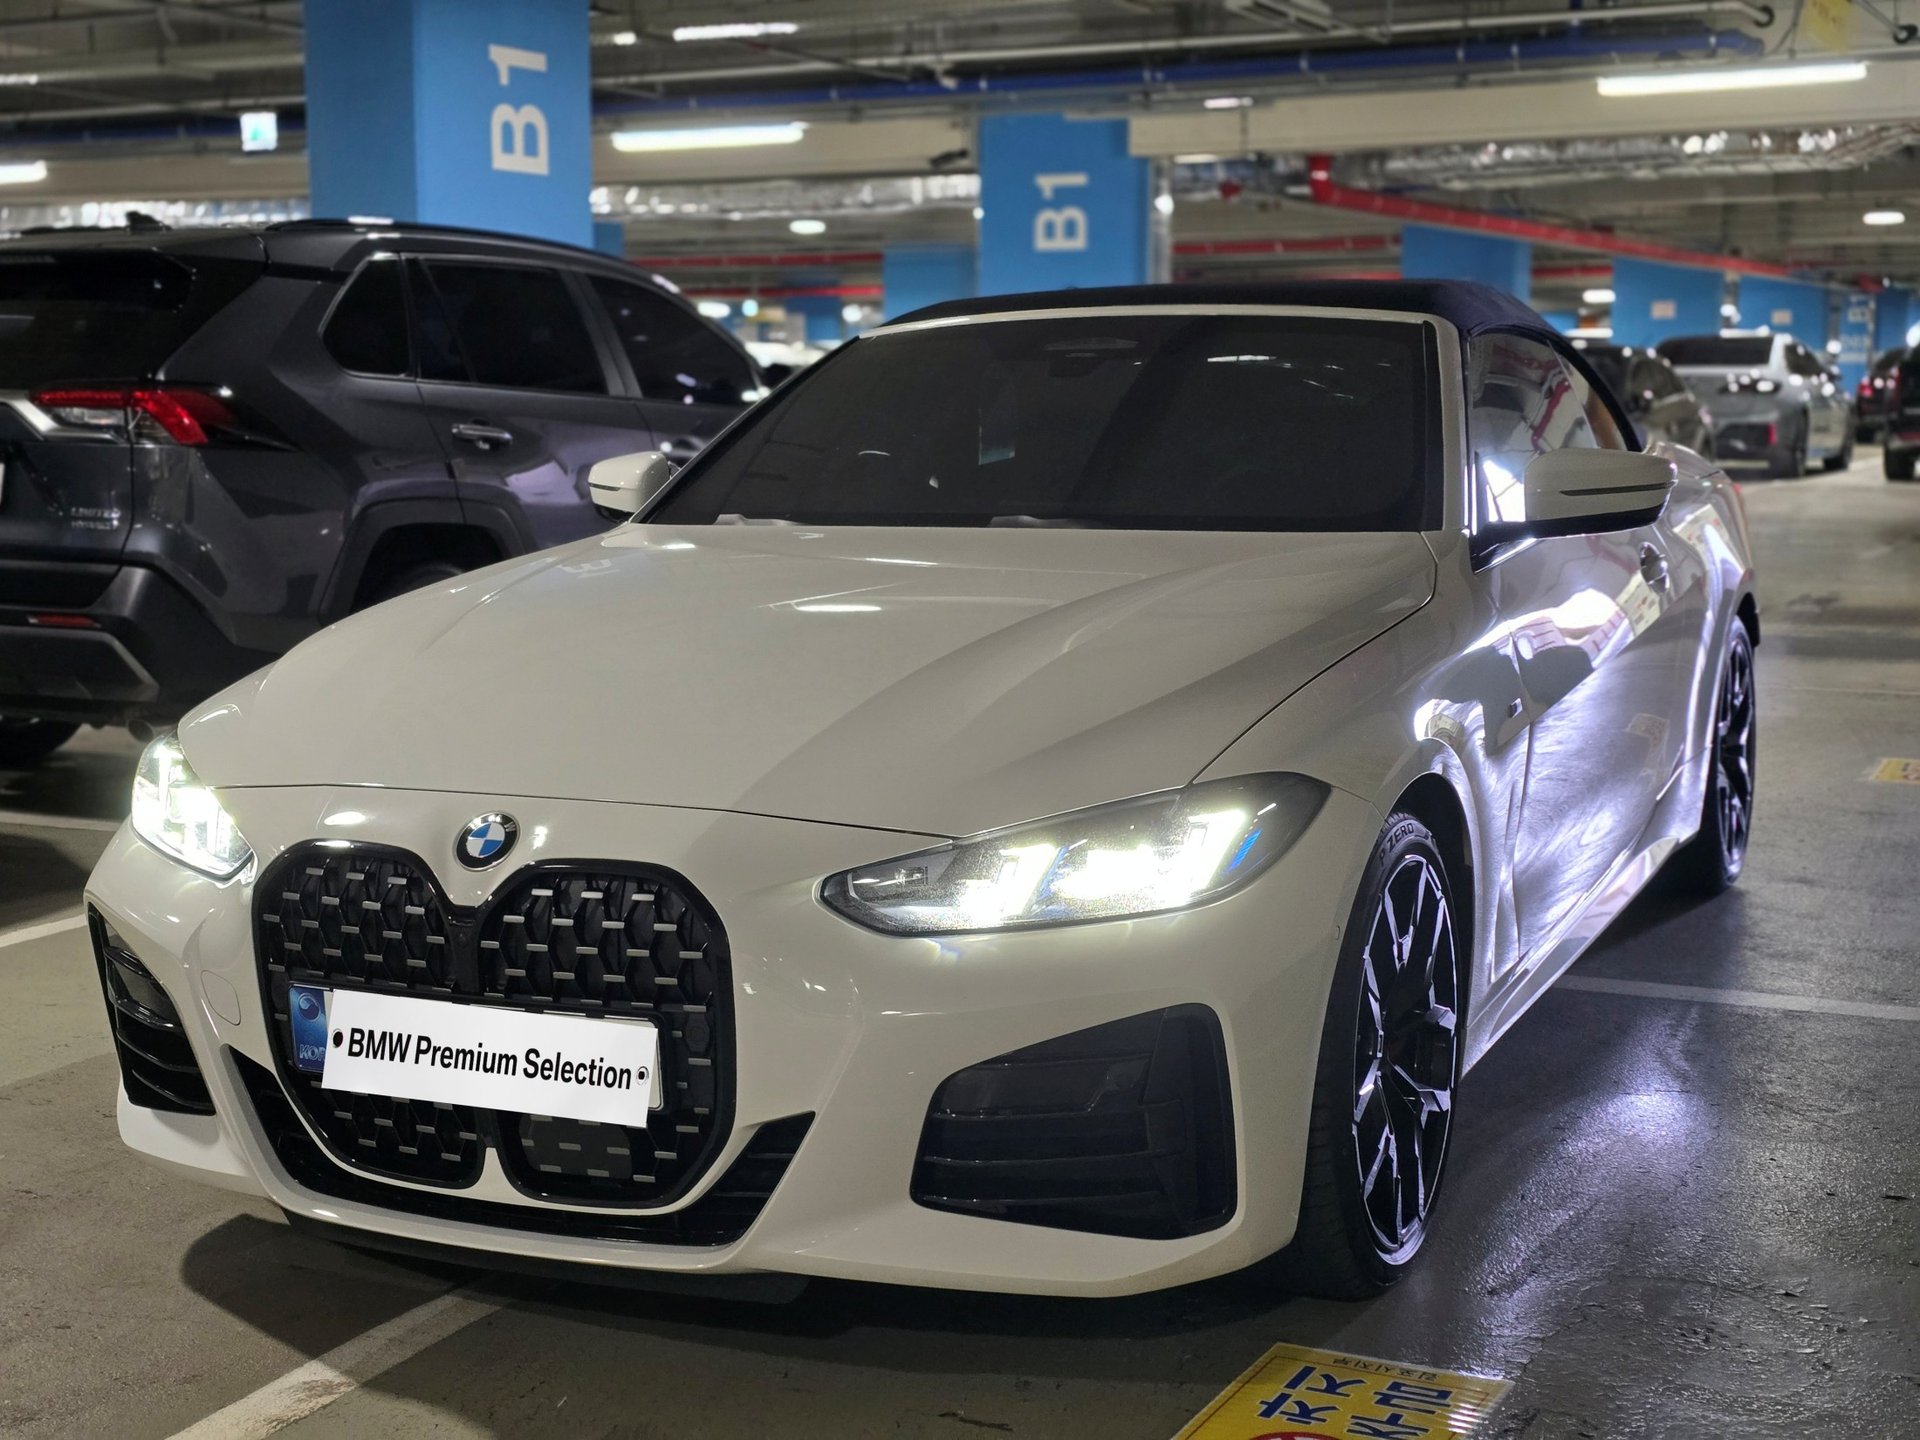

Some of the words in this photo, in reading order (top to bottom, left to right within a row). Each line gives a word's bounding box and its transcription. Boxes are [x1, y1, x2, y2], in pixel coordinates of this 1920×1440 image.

[489, 44, 549, 175] B1
[1034, 173, 1088, 251] B1
[1378, 848, 1386, 867] P
[1387, 823, 1415, 852] ZERO
[348, 1027, 412, 1063] BMW
[414, 1035, 517, 1077] Premium
[523, 1048, 632, 1090] Selection
